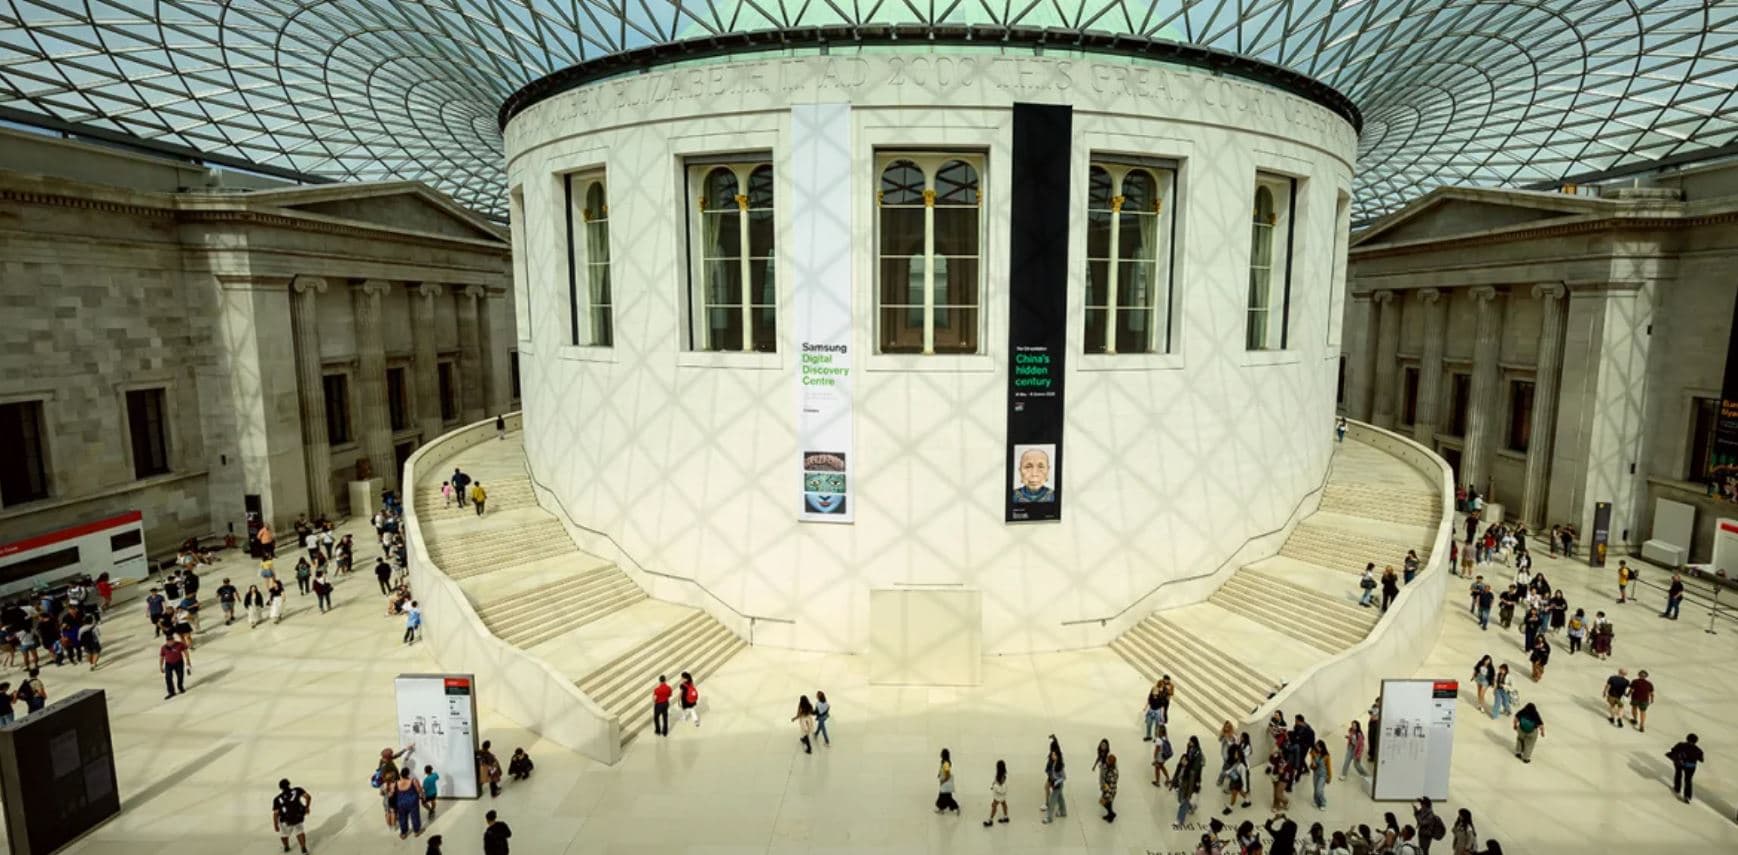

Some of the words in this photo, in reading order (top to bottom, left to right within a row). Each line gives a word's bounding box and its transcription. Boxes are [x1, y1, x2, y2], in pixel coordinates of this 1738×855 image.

[817, 57, 870, 88] AD
[888, 56, 977, 87] 2000
[802, 343, 847, 354] Samsung
[802, 354, 832, 364] Digital
[1016, 354, 1050, 363] China's
[802, 365, 849, 376] Discovery
[1016, 366, 1048, 375] hidden
[802, 376, 835, 386] Centre
[1015, 377, 1051, 388] century
